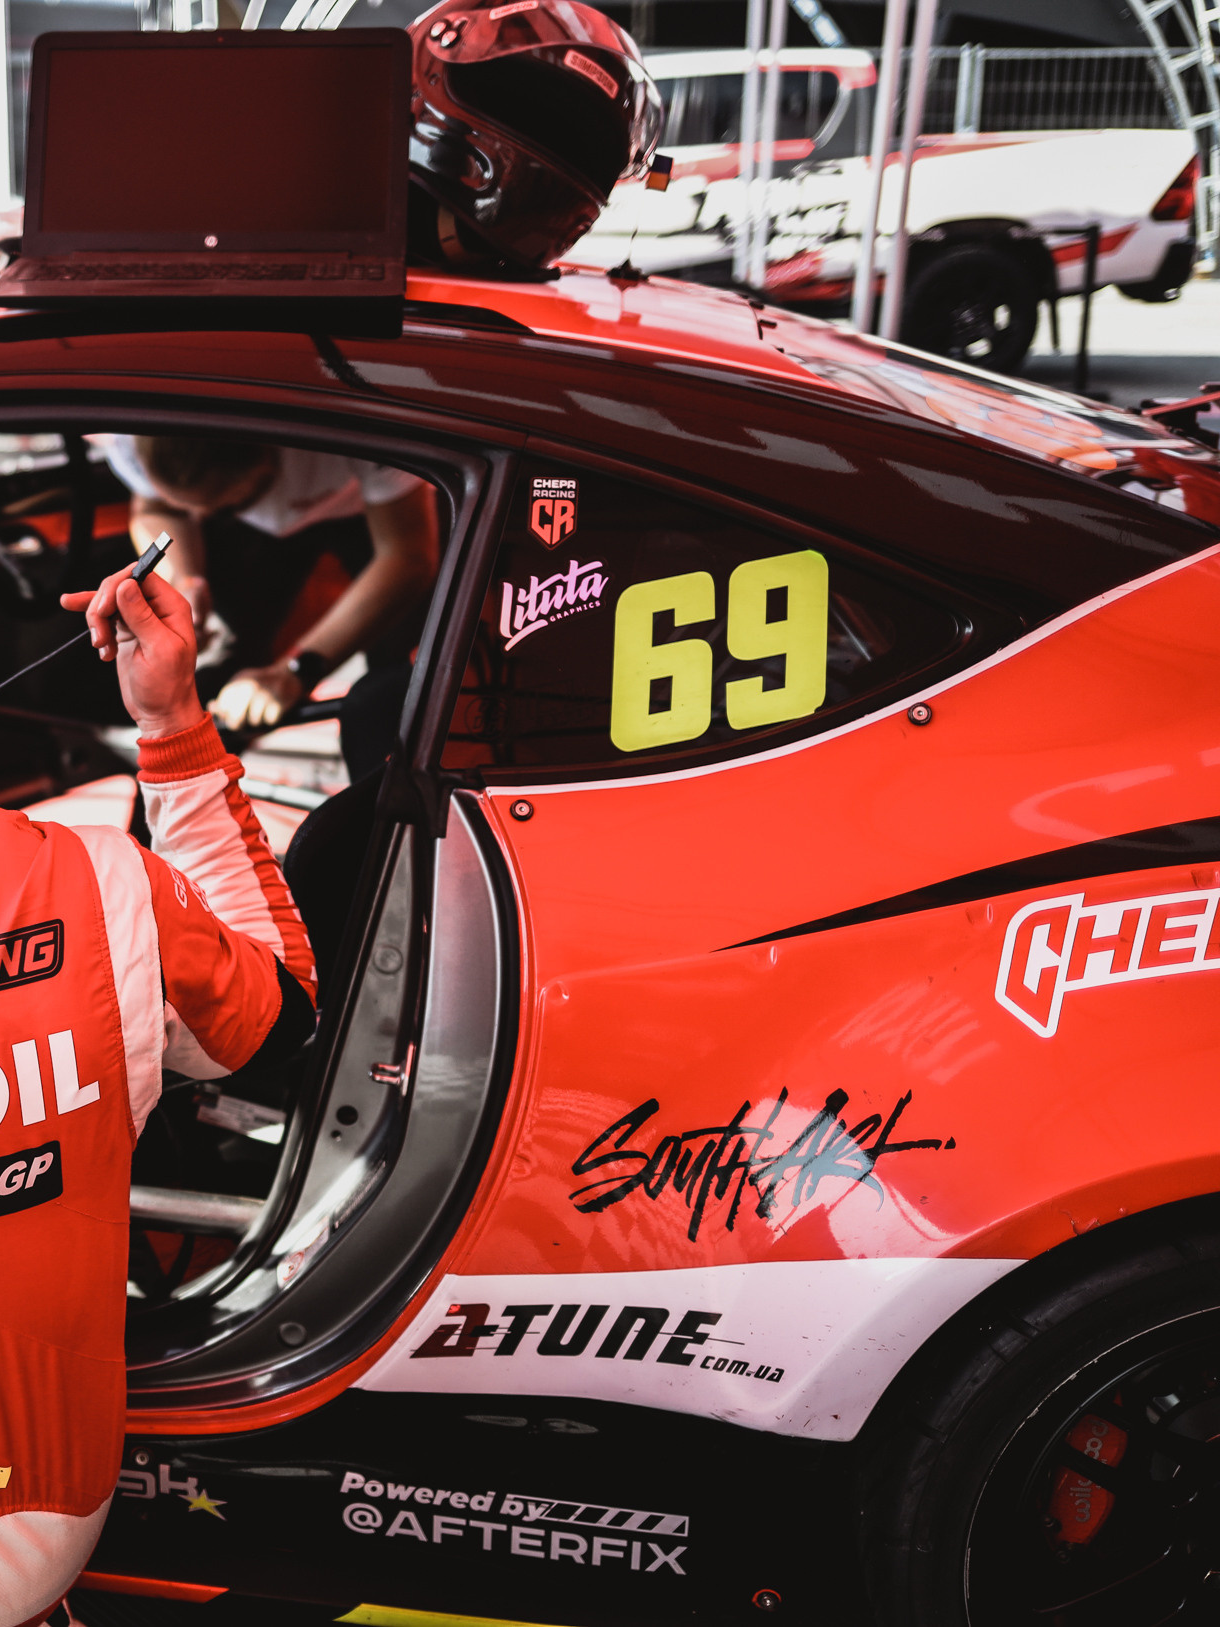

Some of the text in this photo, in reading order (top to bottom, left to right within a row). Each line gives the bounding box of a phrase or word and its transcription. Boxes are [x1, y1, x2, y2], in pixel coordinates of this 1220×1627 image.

[533, 479, 576, 489] CHEPA
[533, 489, 575, 498] RACING
[531, 498, 575, 545] CR
[549, 600, 601, 622] GRAPHICS
[610, 549, 829, 753] 69
[996, 893, 1220, 1036] CHE
[700, 1355, 785, 1383] com.ua
[340, 1471, 550, 1522] Powered by
[342, 1502, 688, 1576] @AFTERFIX
